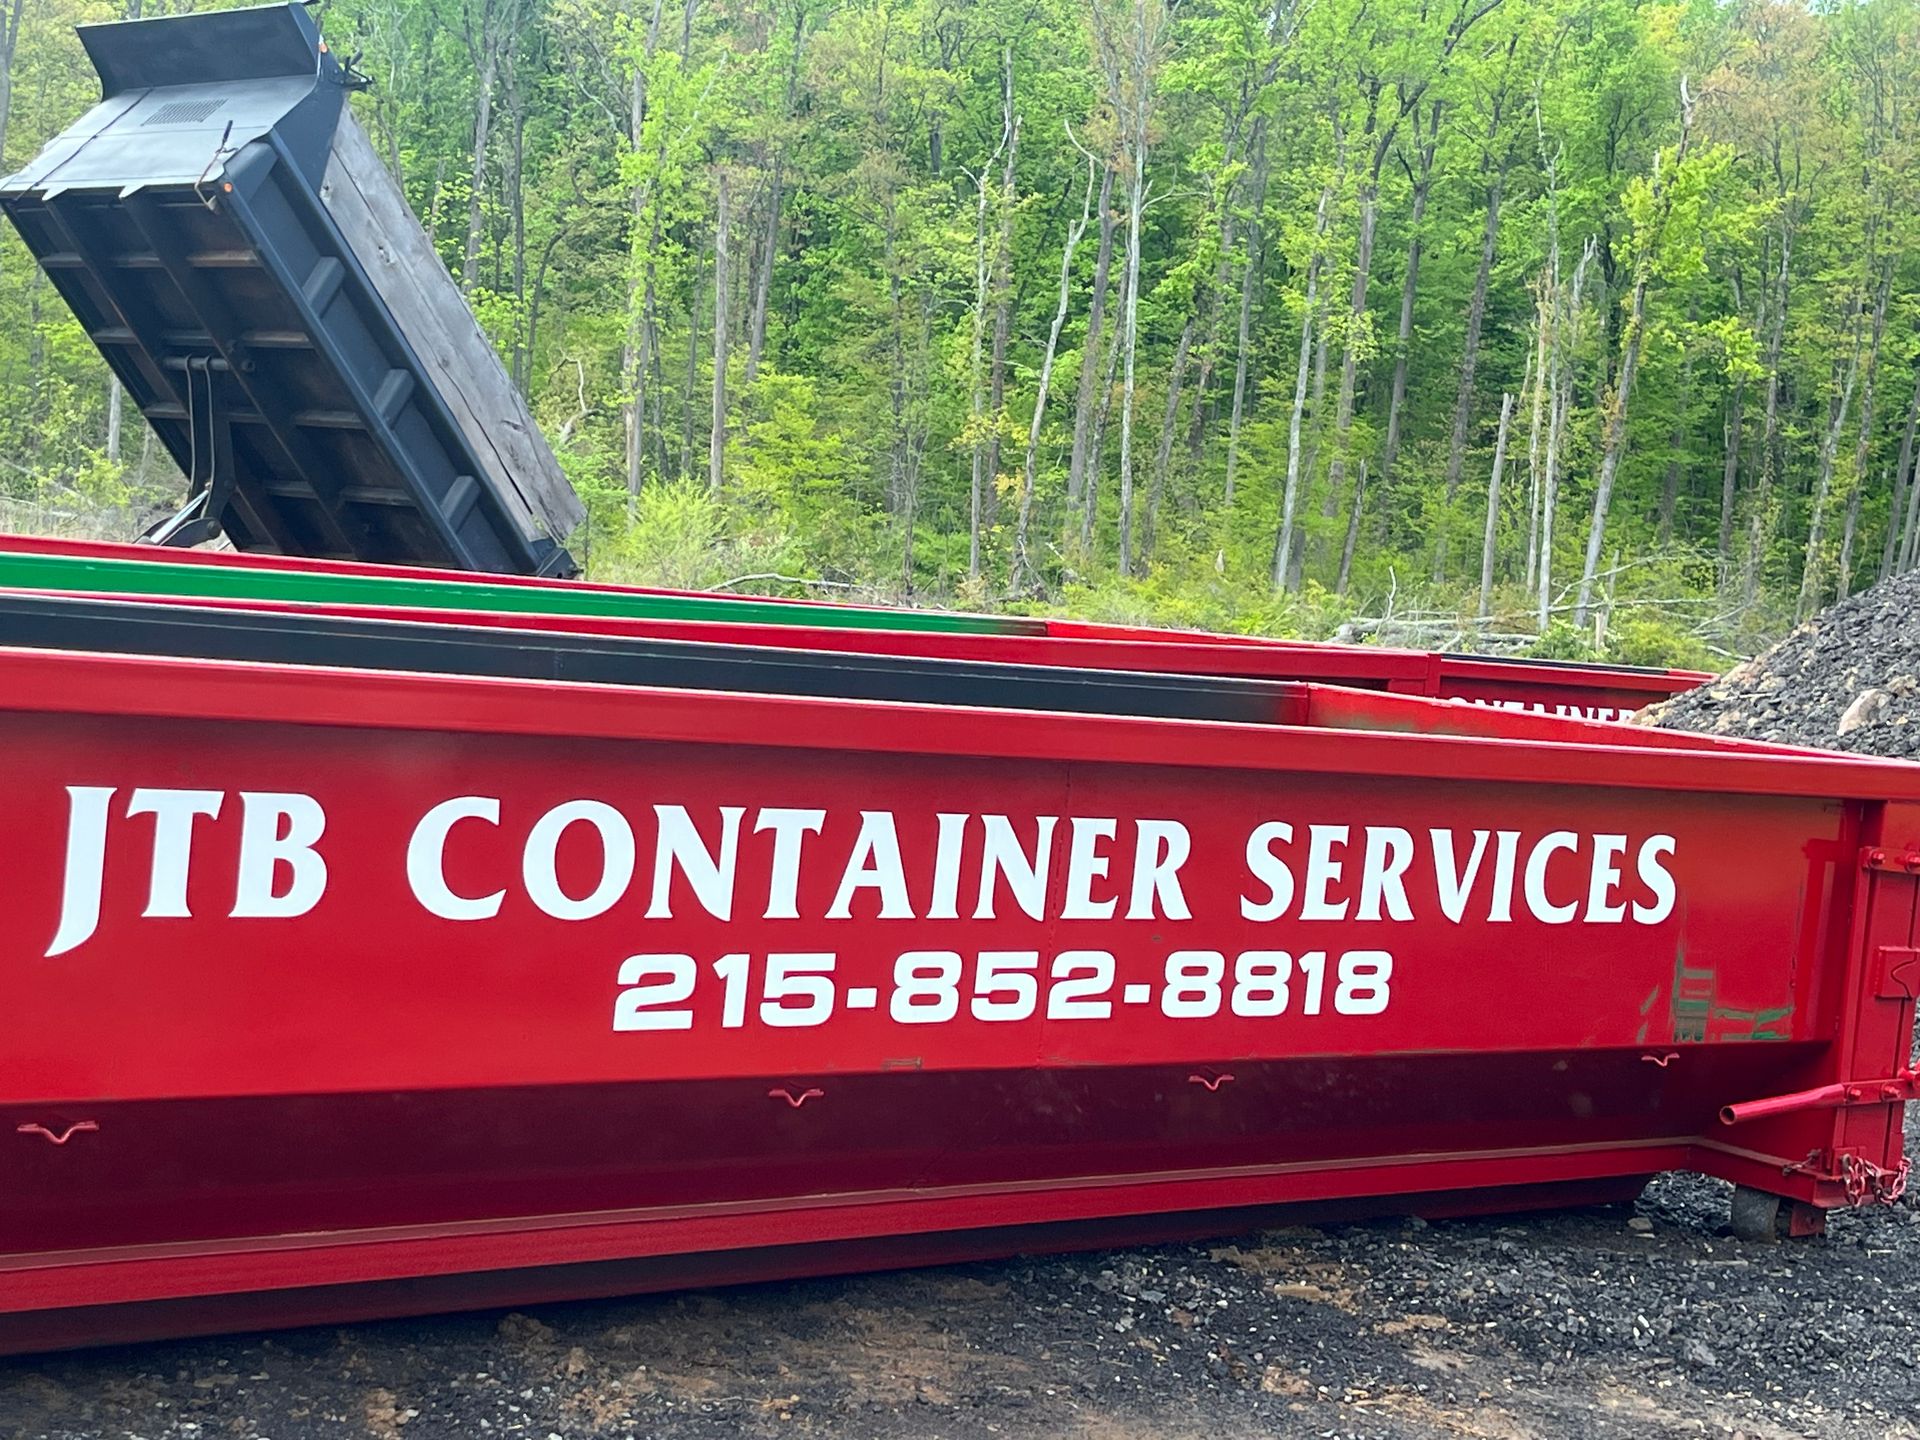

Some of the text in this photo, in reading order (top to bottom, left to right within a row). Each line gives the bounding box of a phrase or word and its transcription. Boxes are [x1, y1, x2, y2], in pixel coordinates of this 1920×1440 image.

[45, 785, 1677, 958] JTB CONTAINER SERVICES
[612, 949, 1394, 1033] 215-852-8818
